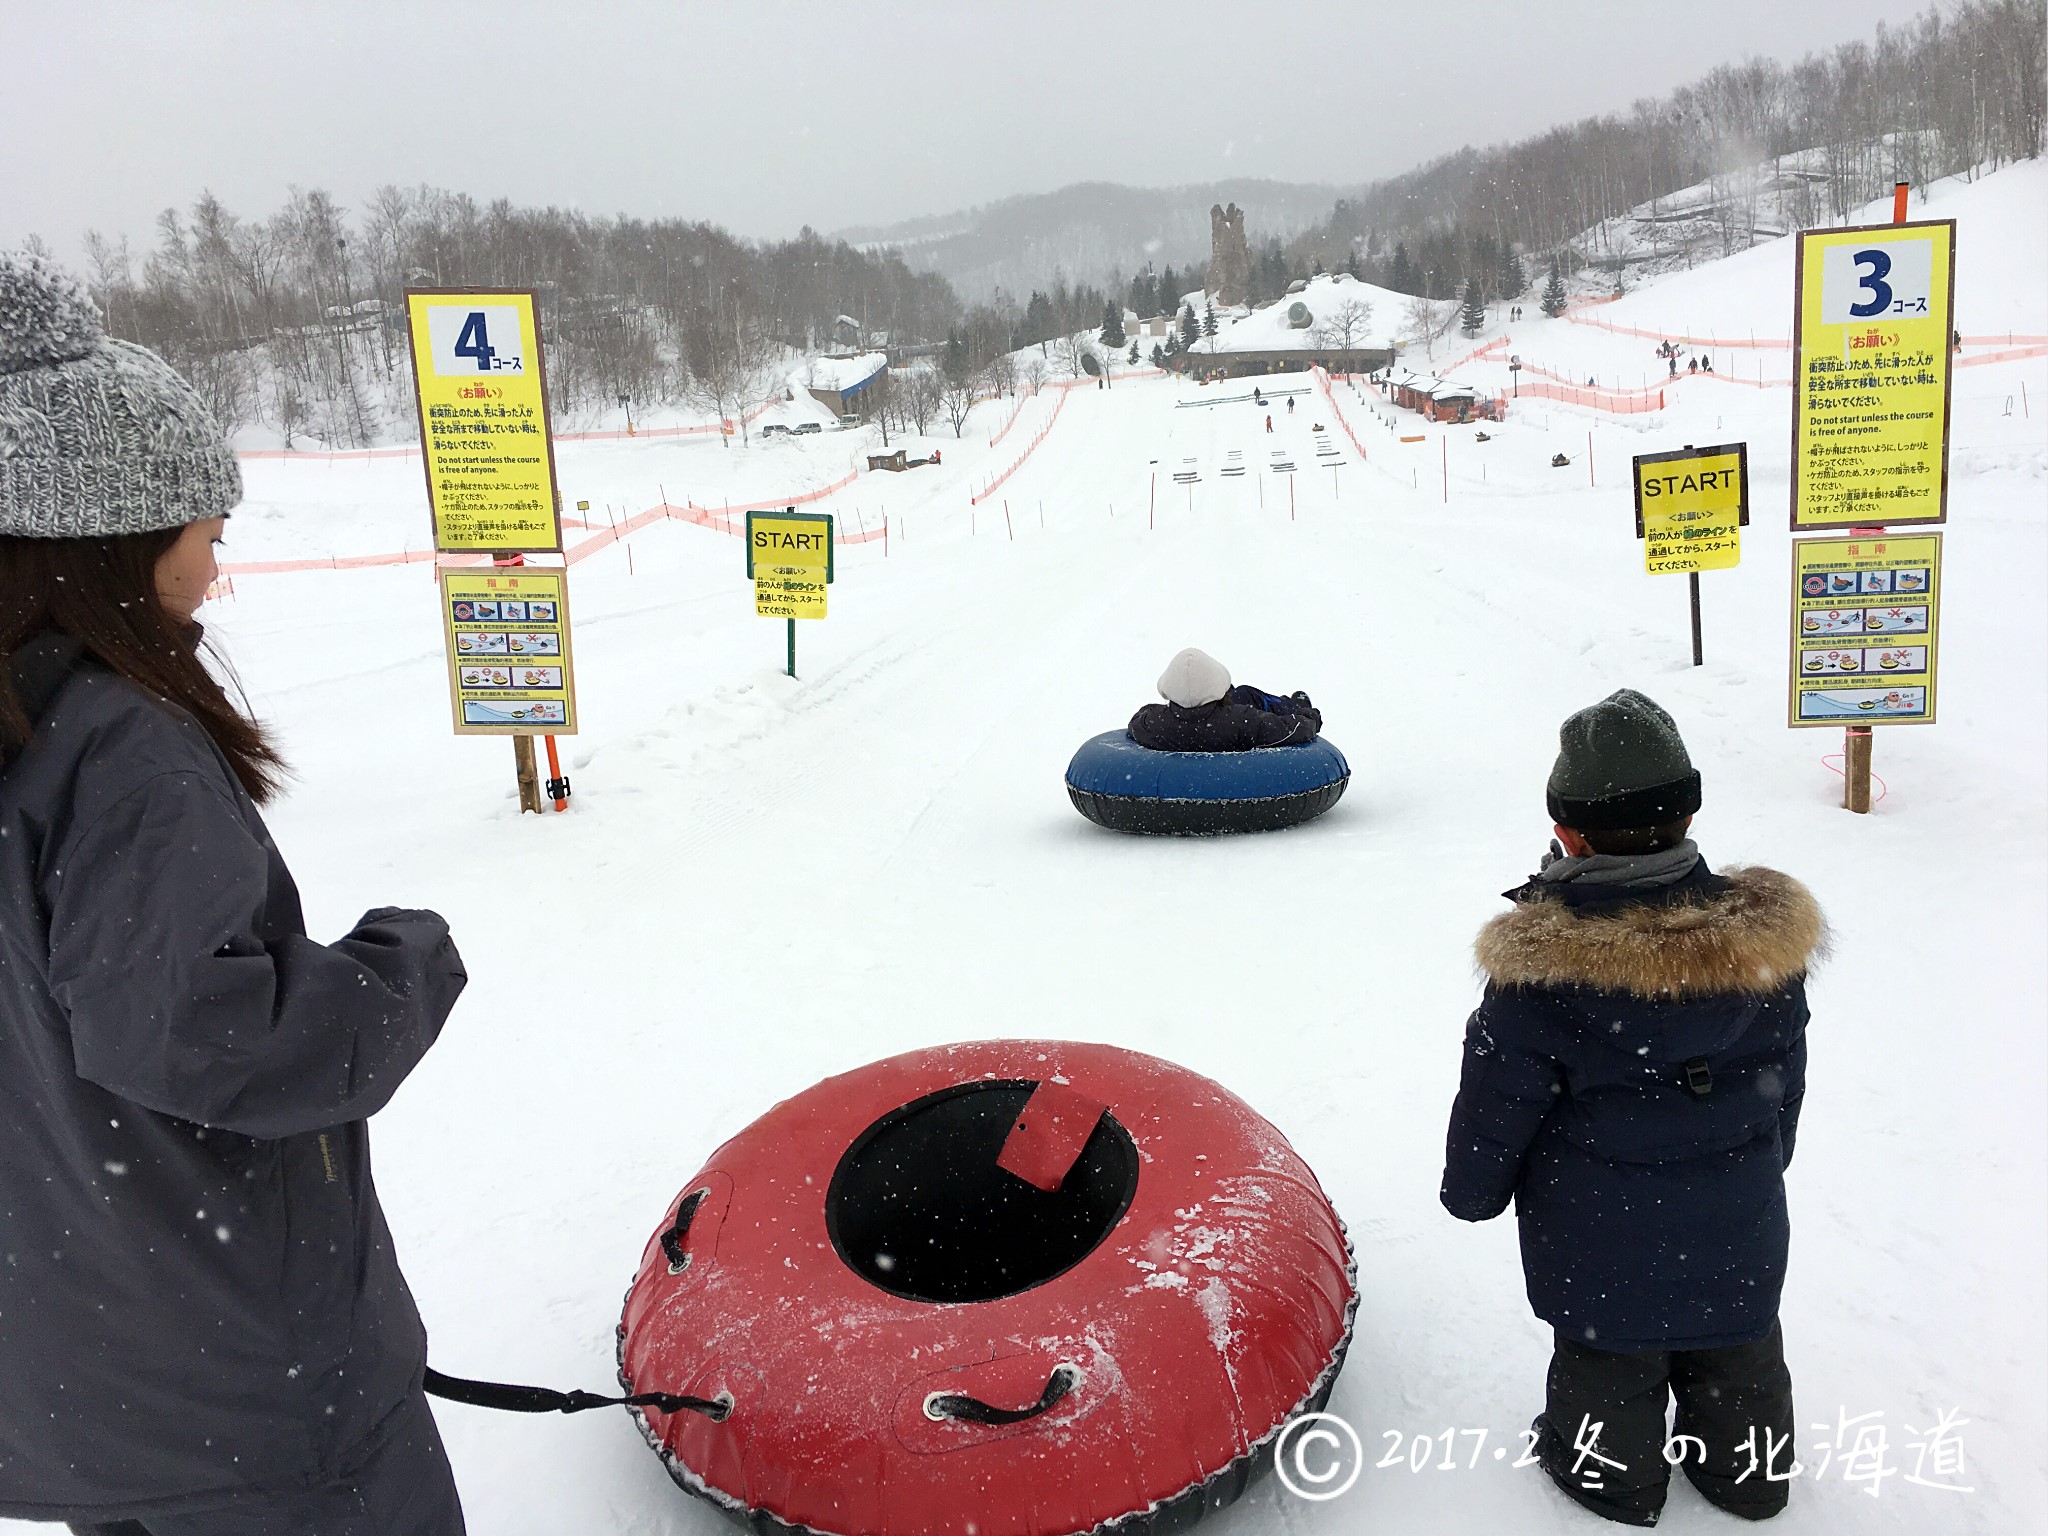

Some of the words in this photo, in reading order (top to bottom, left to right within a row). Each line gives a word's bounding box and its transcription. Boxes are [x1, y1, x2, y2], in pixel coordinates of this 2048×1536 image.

[1810, 417, 1821, 425] Do
[1824, 416, 1838, 424] not
[1840, 415, 1860, 424] start
[1861, 413, 1888, 422] unless
[1890, 412, 1904, 421] the
[1906, 411, 1934, 419] course
[1810, 428, 1817, 436] is
[1818, 427, 1835, 436] free
[1837, 426, 1846, 435] of
[1847, 426, 1881, 436] anyone.
[1645, 469, 1735, 497] START
[755, 531, 824, 550] START
